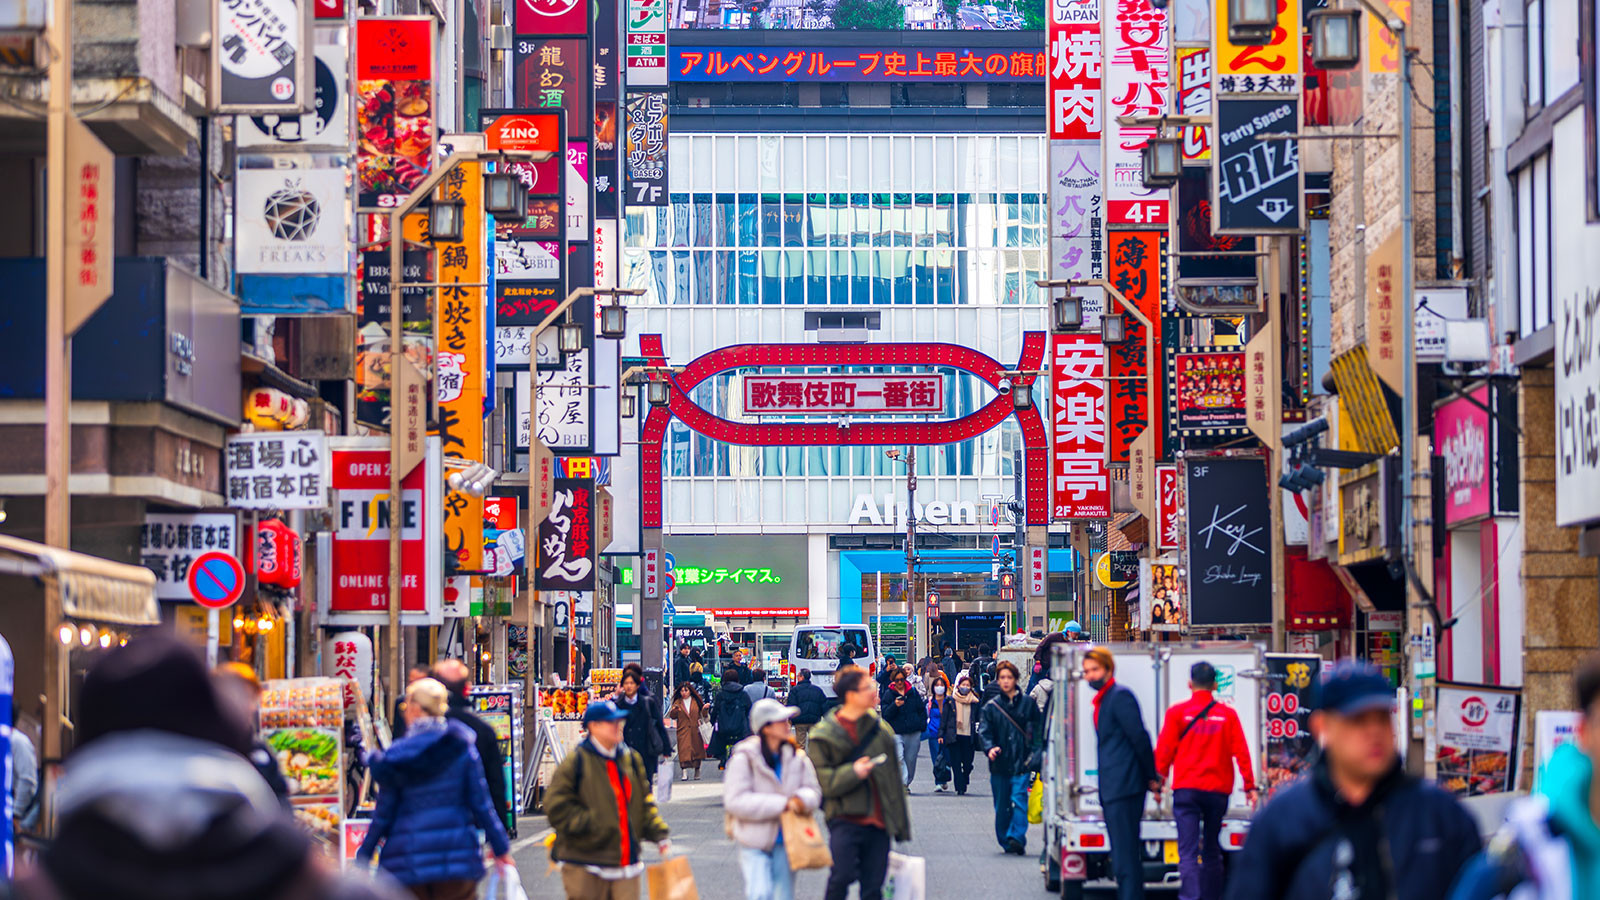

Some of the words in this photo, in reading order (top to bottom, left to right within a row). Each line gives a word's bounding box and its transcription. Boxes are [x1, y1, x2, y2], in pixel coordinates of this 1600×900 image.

[1057, 10, 1098, 20] JAPAN
[519, 41, 535, 54] 3F
[634, 34, 660, 44] たばこ
[635, 58, 658, 67] ATM
[275, 83, 292, 94] B1
[1052, 30, 1101, 134] 焼肉
[1219, 75, 1295, 93] 博多天神
[500, 127, 539, 138] ZINO
[648, 95, 664, 155] ビアポン
[1221, 121, 1255, 146] Party
[1252, 104, 1292, 130] Space
[632, 109, 648, 168] &ダーツ
[568, 149, 587, 164] 2F
[633, 183, 662, 202] 7F
[1125, 203, 1160, 223] 4F
[1266, 201, 1286, 212] B1
[261, 251, 326, 262] FREAKS
[545, 242, 558, 253] 2F
[443, 168, 472, 350] 博多鍋水炊き
[751, 381, 936, 408] 歌舞伎町一番街
[408, 384, 419, 453] 劇場通り一番街
[1055, 339, 1107, 500] 安楽亭
[563, 434, 587, 445] B1F
[229, 439, 318, 470] 酒場心
[350, 463, 381, 476] OPEN
[1194, 466, 1209, 477] 3F
[230, 474, 320, 500] 新宿本店
[540, 457, 548, 507] 劇場通り一番街
[342, 500, 416, 528] FINE
[848, 493, 976, 533] Alpen
[1055, 506, 1072, 516] 2F
[1198, 504, 1265, 556] Key
[647, 552, 656, 594] 劇場通り
[1033, 550, 1042, 592] 劇場通り
[340, 576, 383, 588] ONLINE
[389, 575, 417, 587] AFE
[371, 594, 386, 606] B1
[1266, 718, 1298, 738] 80
